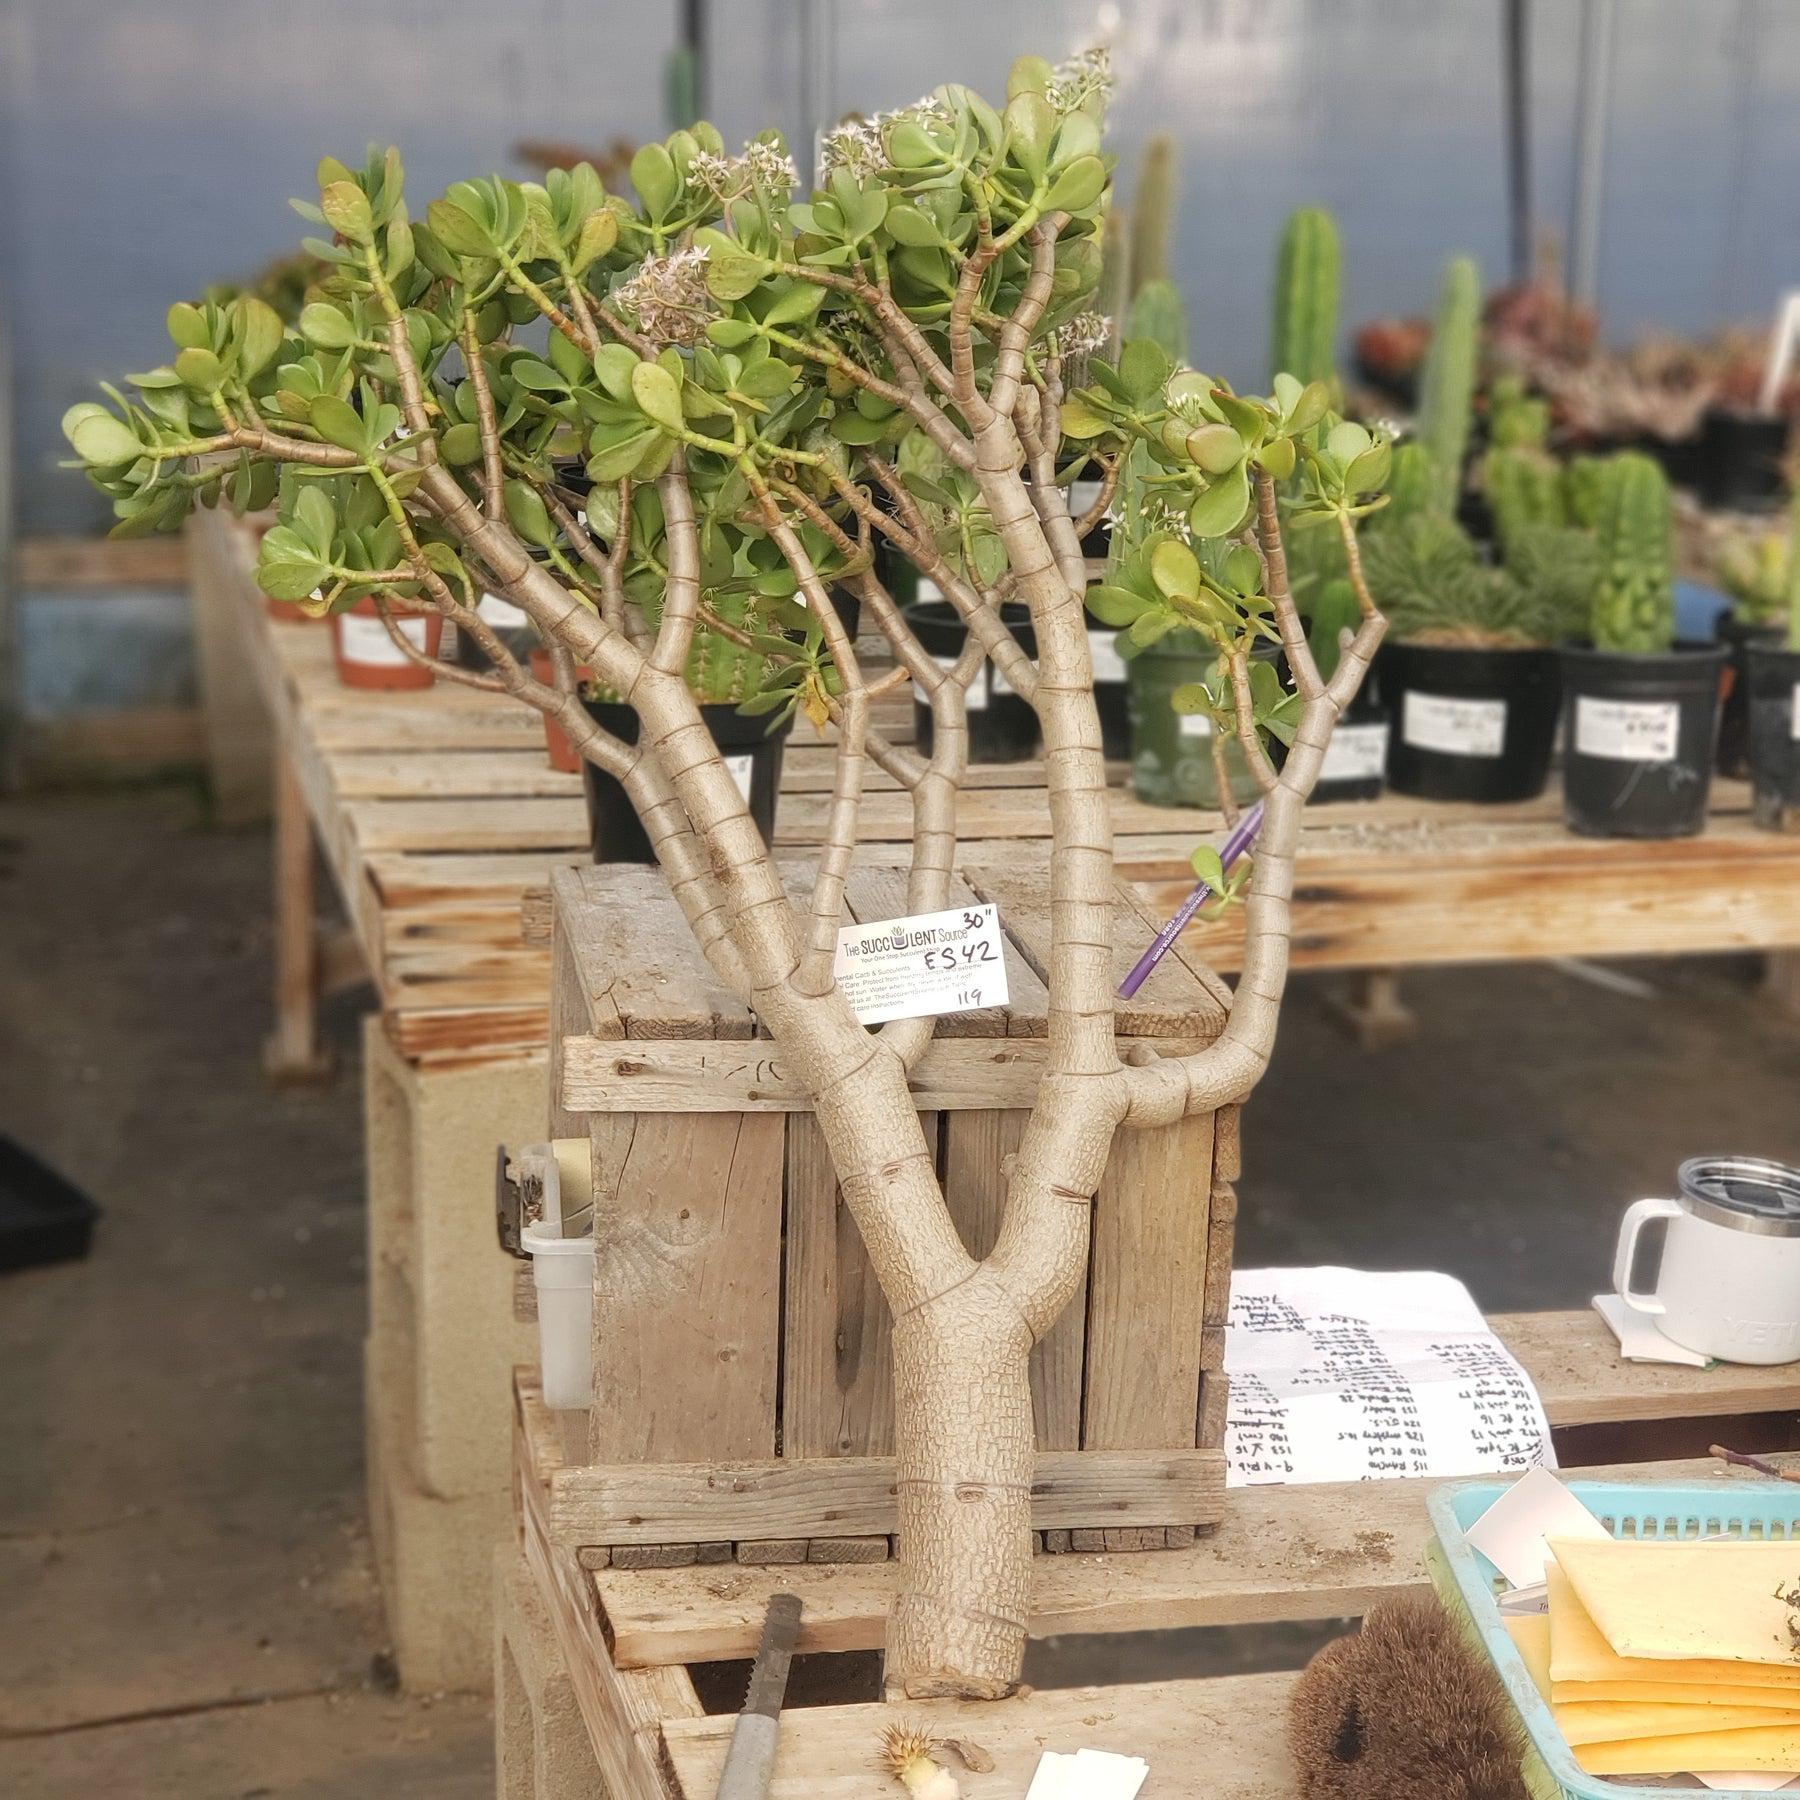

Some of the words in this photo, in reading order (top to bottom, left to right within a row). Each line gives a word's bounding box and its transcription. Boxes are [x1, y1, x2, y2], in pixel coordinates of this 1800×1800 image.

[963, 908, 991, 930] 30"
[938, 928, 968, 943] Source
[860, 956, 873, 964] Your
[874, 953, 885, 961] One
[887, 952, 899, 960] Stop
[900, 948, 926, 958] Succulent
[878, 965, 910, 975] Succulents
[863, 977, 884, 985] Protect
[958, 989, 982, 1007] 119
